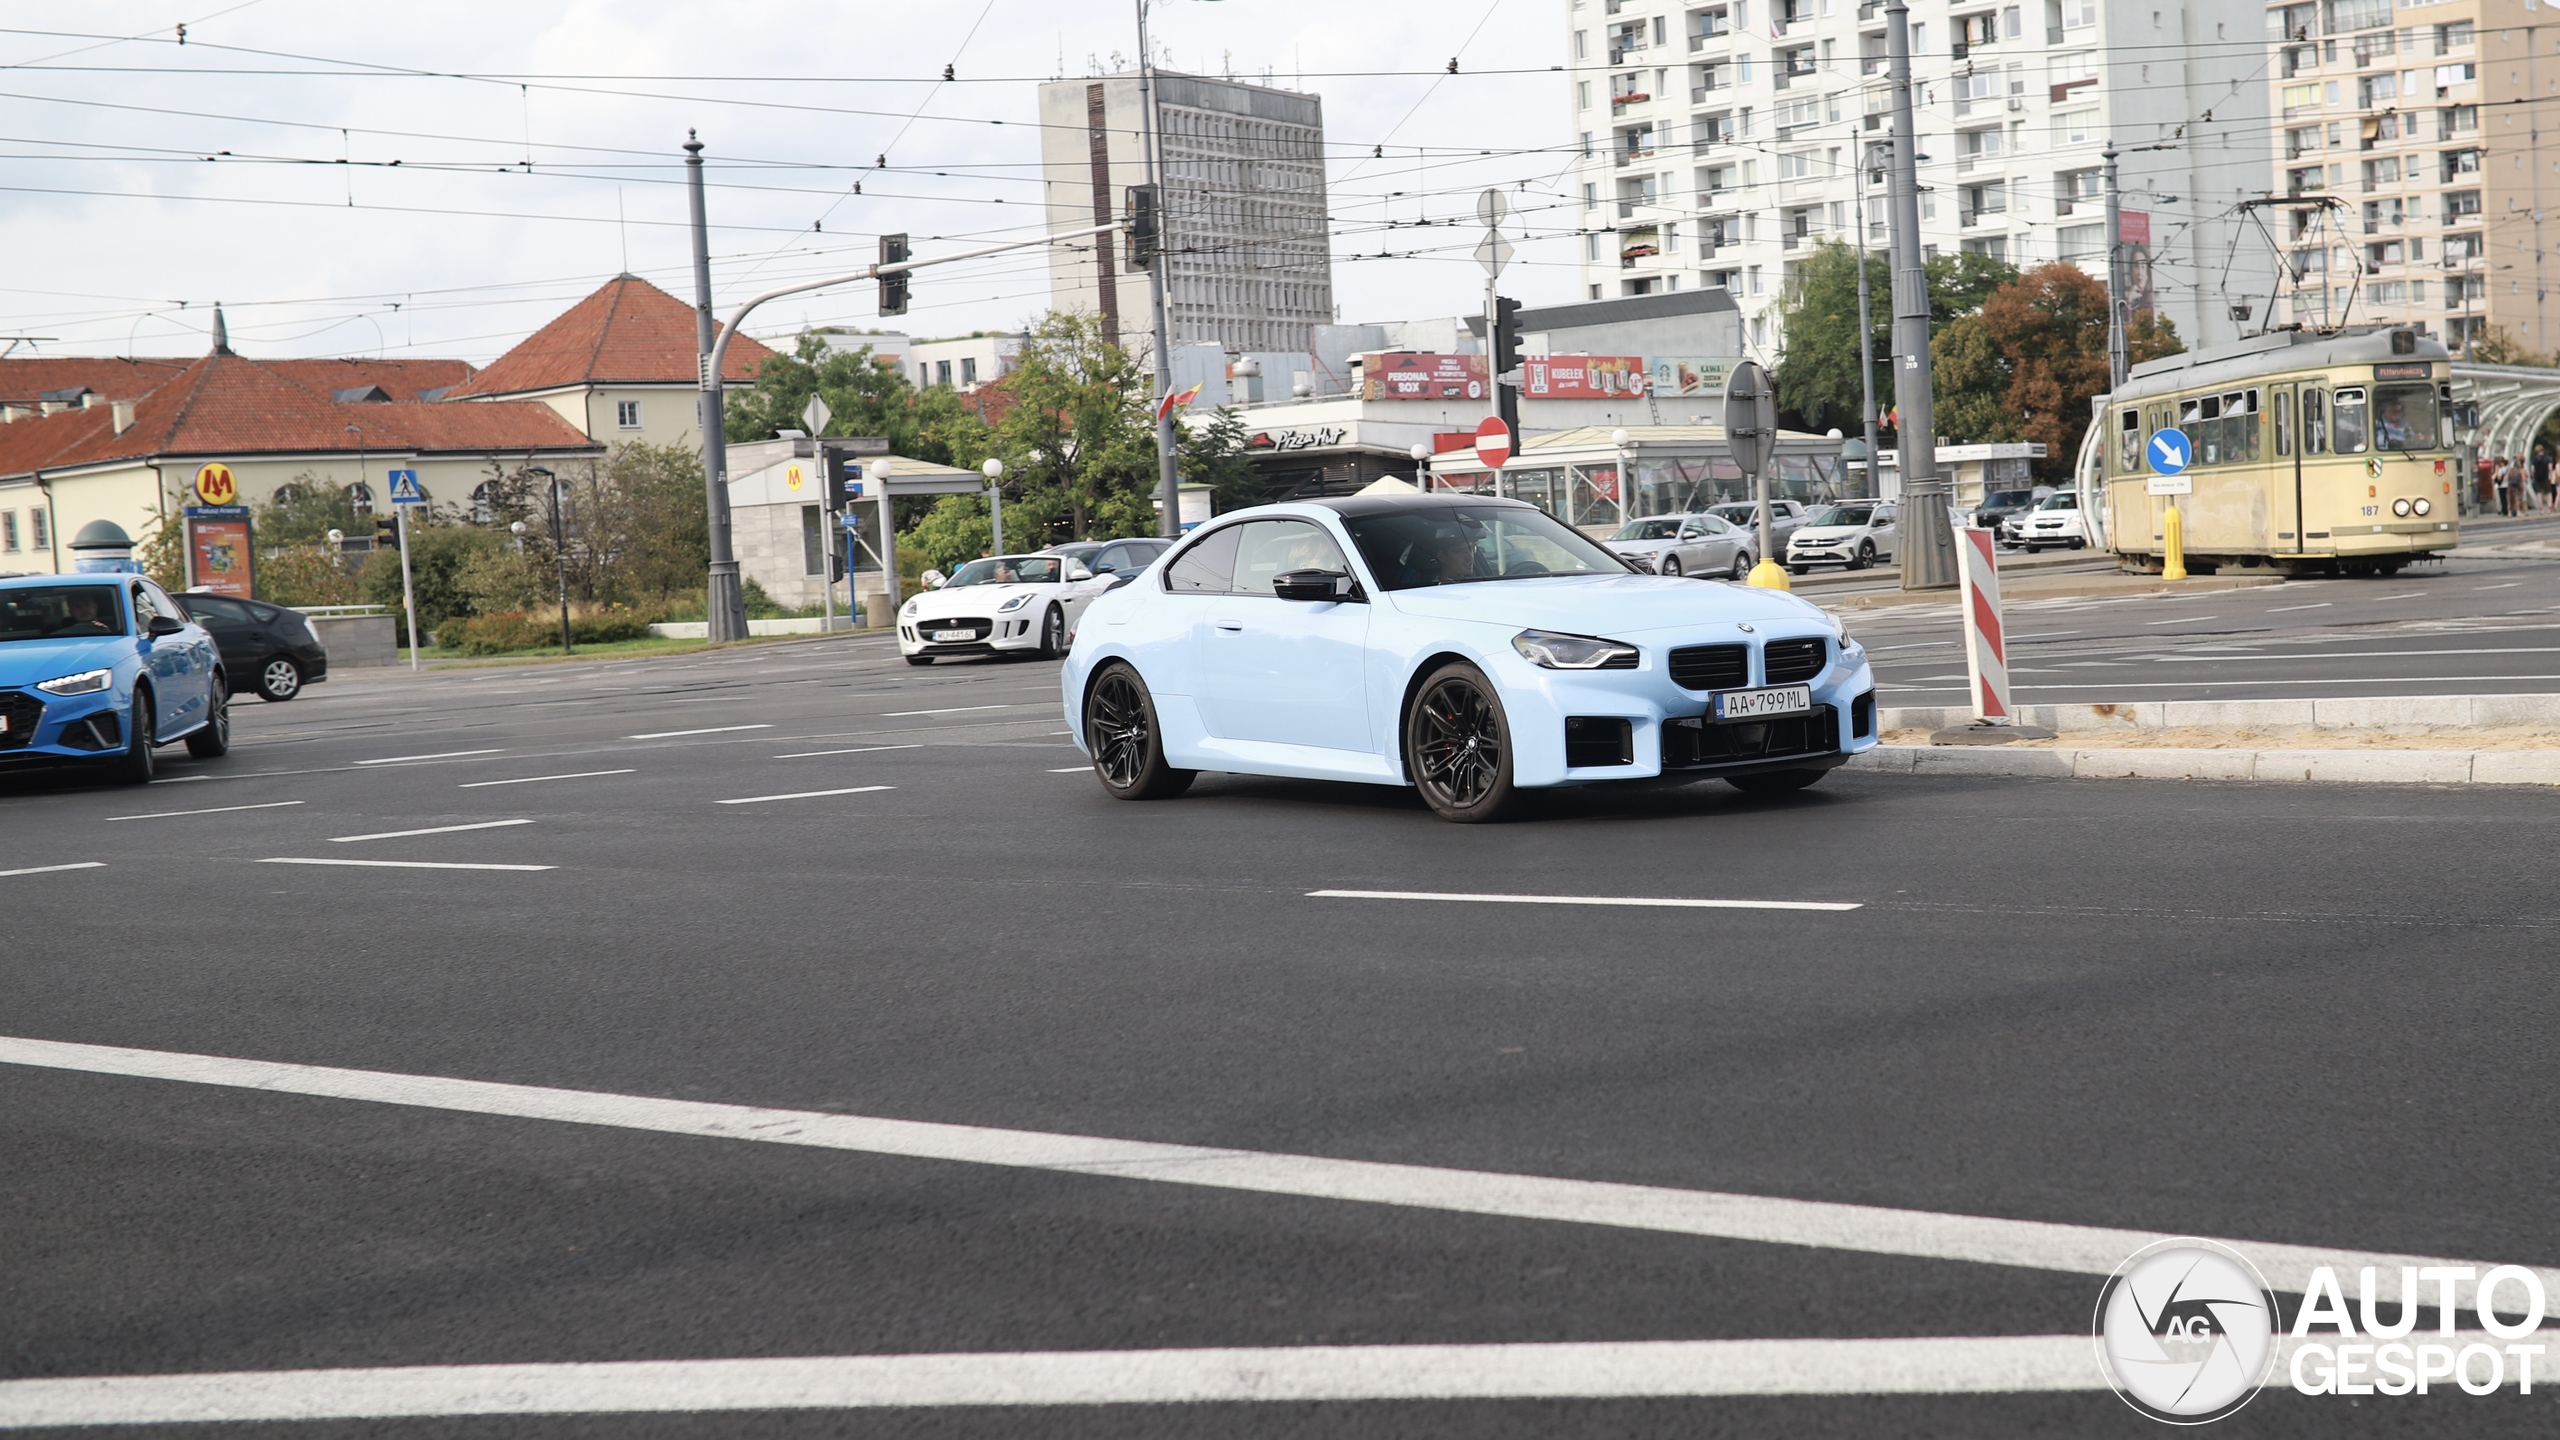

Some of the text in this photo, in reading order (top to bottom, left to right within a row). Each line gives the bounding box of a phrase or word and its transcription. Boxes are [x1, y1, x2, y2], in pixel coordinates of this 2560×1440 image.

[1551, 368, 1585, 379] KUBEŁEK
[1700, 365, 1721, 373] KAWA
[1387, 372, 1430, 381] PERSONAL
[1398, 382, 1420, 393] BOX
[1275, 427, 1346, 451] Pizza Hut
[2361, 506, 2379, 516] 187
[1729, 690, 1806, 715] AA 799ML
[1716, 708, 1725, 716] SK
